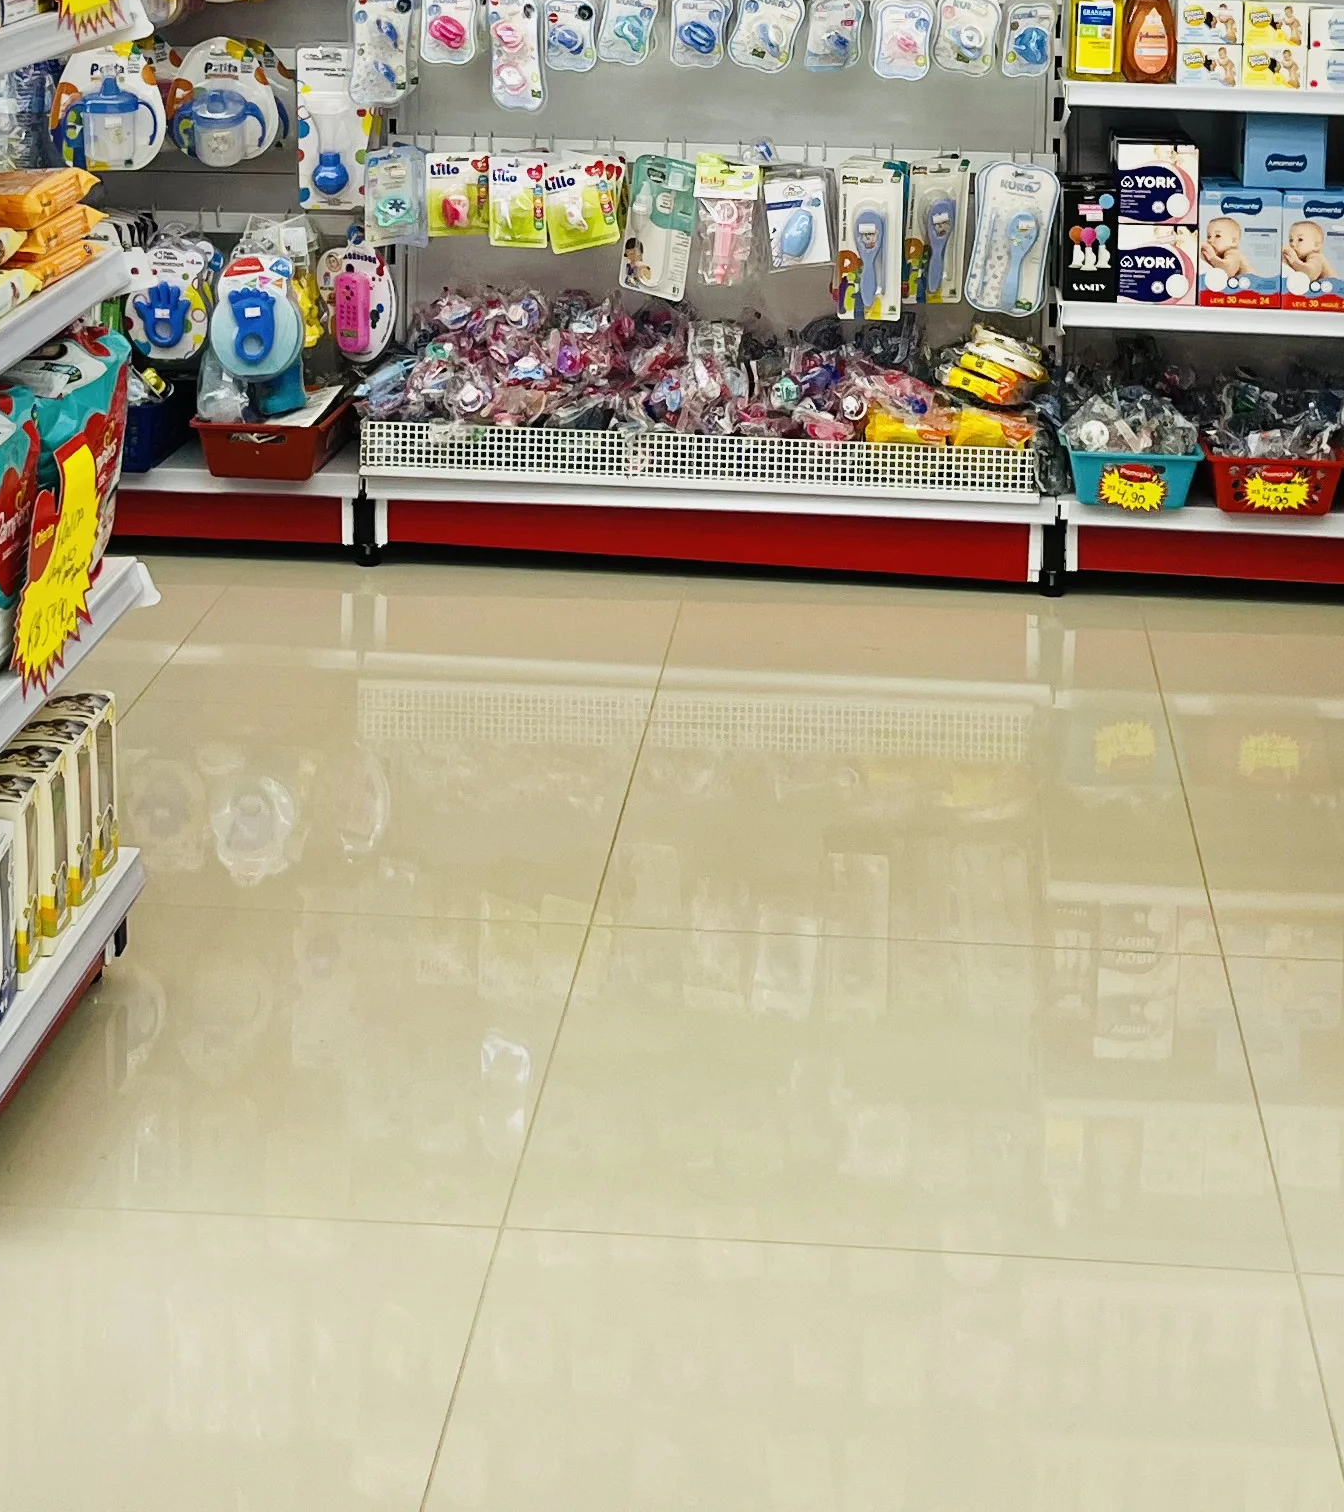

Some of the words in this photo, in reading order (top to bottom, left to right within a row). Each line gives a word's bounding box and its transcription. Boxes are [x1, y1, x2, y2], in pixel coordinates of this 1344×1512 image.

[430, 162, 459, 177] Lillo
[545, 174, 576, 190] Lillo
[1135, 176, 1176, 189] YORK
[1135, 256, 1176, 269] YORK
